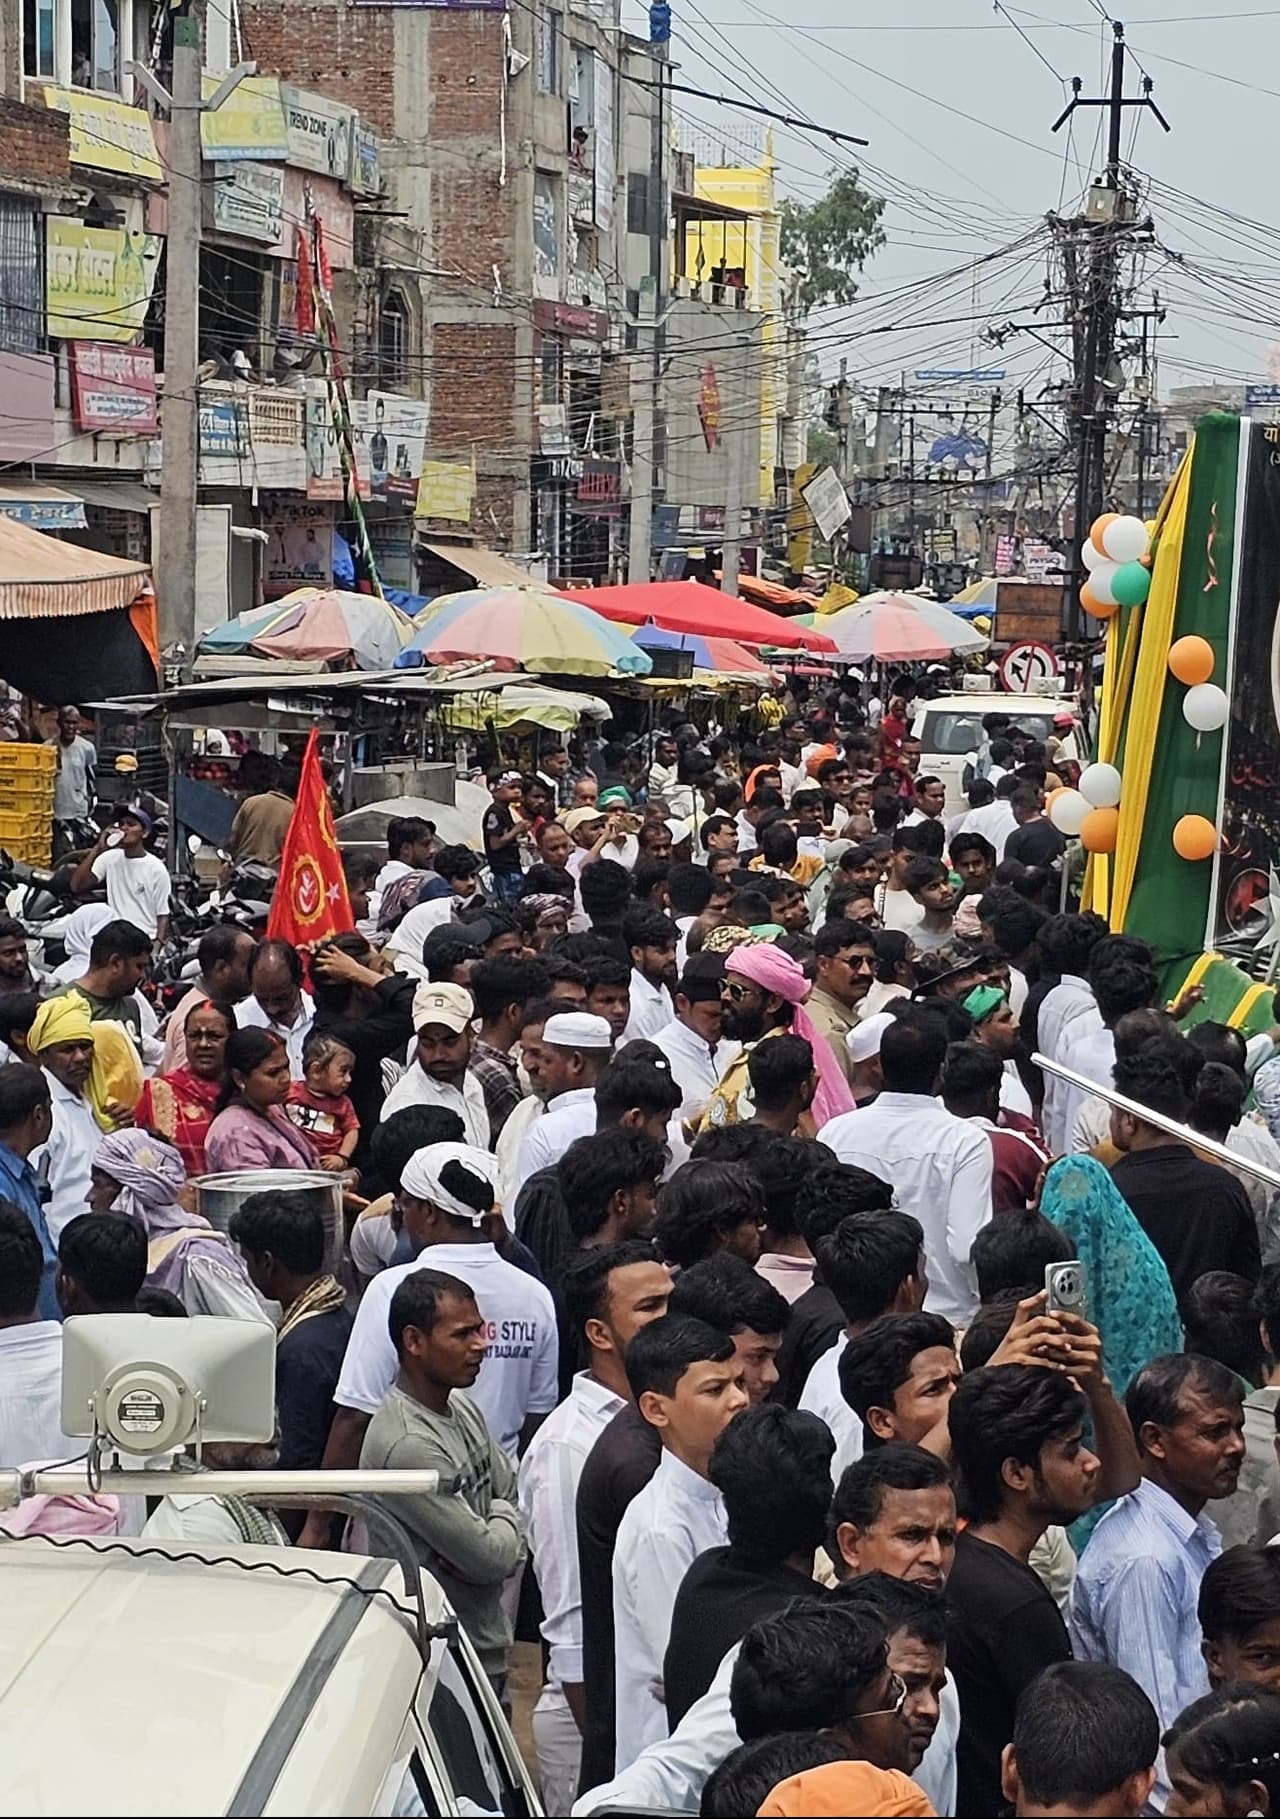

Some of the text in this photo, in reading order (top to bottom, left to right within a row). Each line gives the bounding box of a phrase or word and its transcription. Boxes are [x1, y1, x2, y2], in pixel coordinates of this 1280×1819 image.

[289, 111, 327, 138] TREND ZONE
[1263, 426, 1279, 443] या
